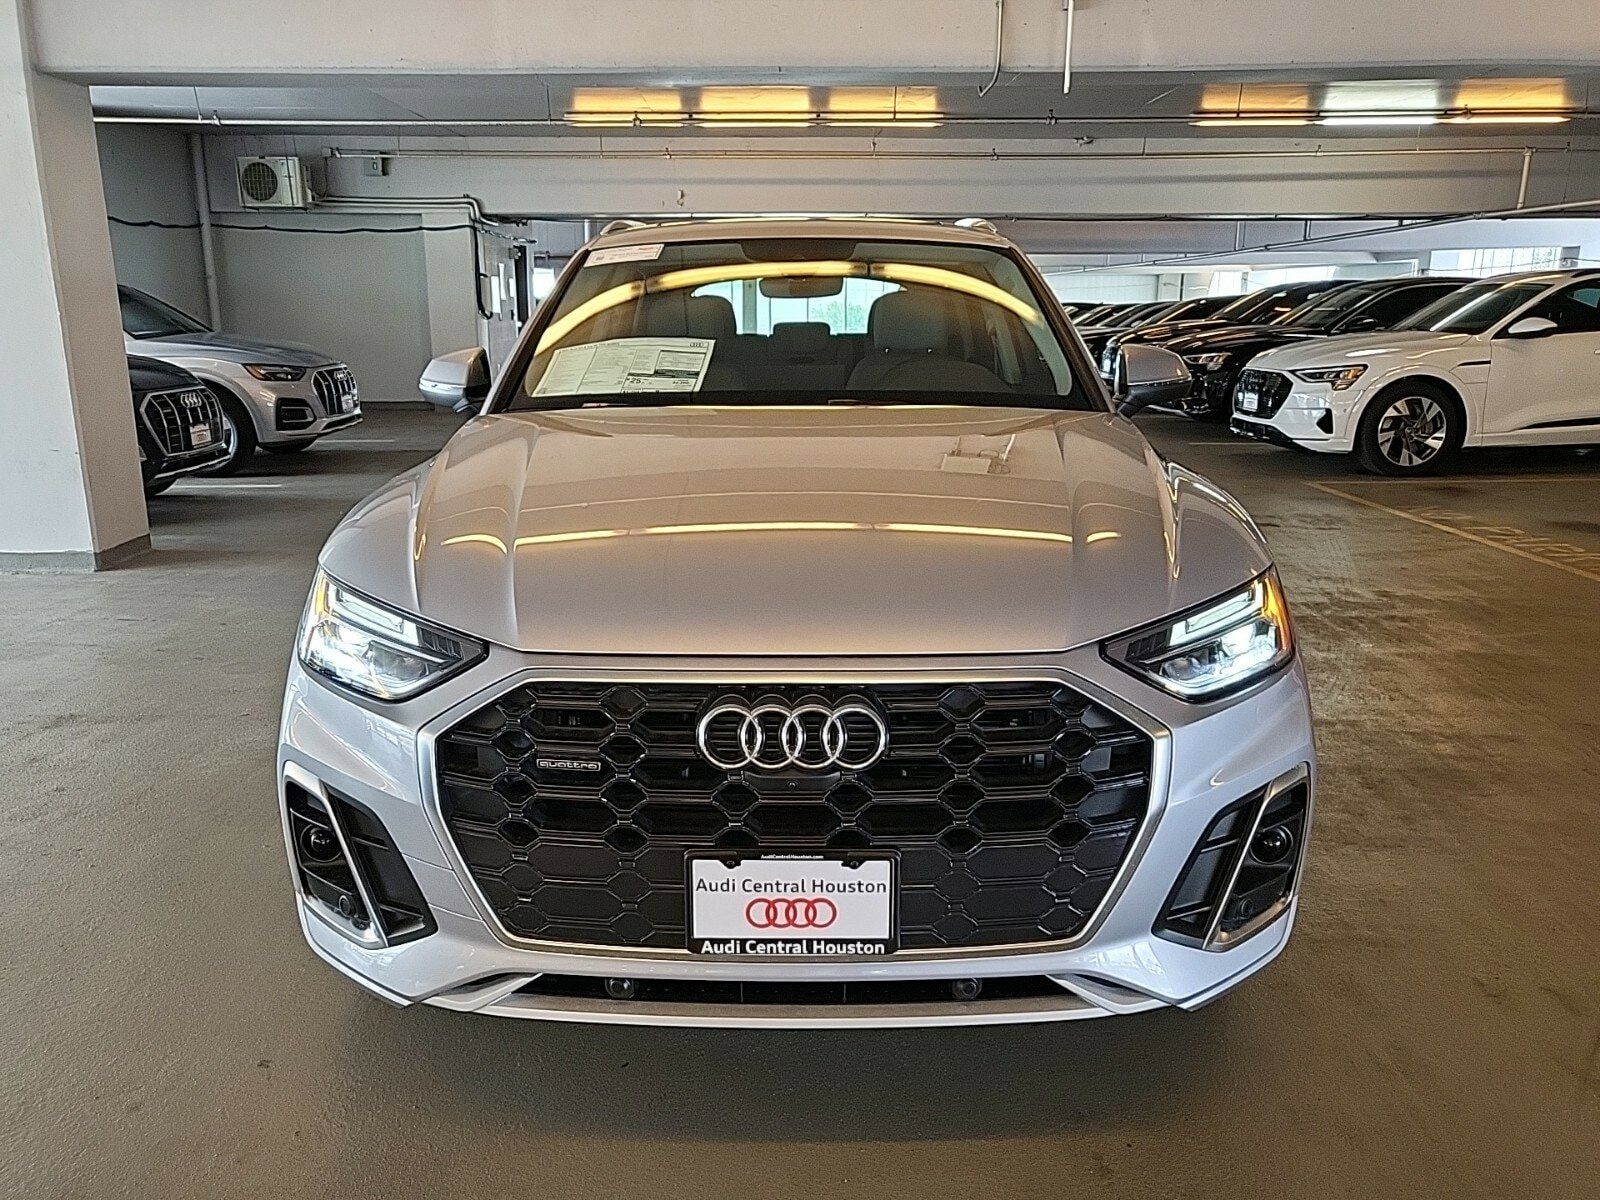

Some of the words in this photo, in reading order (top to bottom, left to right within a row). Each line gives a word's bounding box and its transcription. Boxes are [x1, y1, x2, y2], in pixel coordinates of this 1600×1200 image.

[539, 761, 598, 770] quattro
[696, 878, 736, 893] Audi
[742, 879, 806, 893] Central
[812, 879, 887, 894] Houston
[701, 940, 741, 955] Audi
[745, 940, 809, 955] Central
[813, 940, 885, 955] Houston
